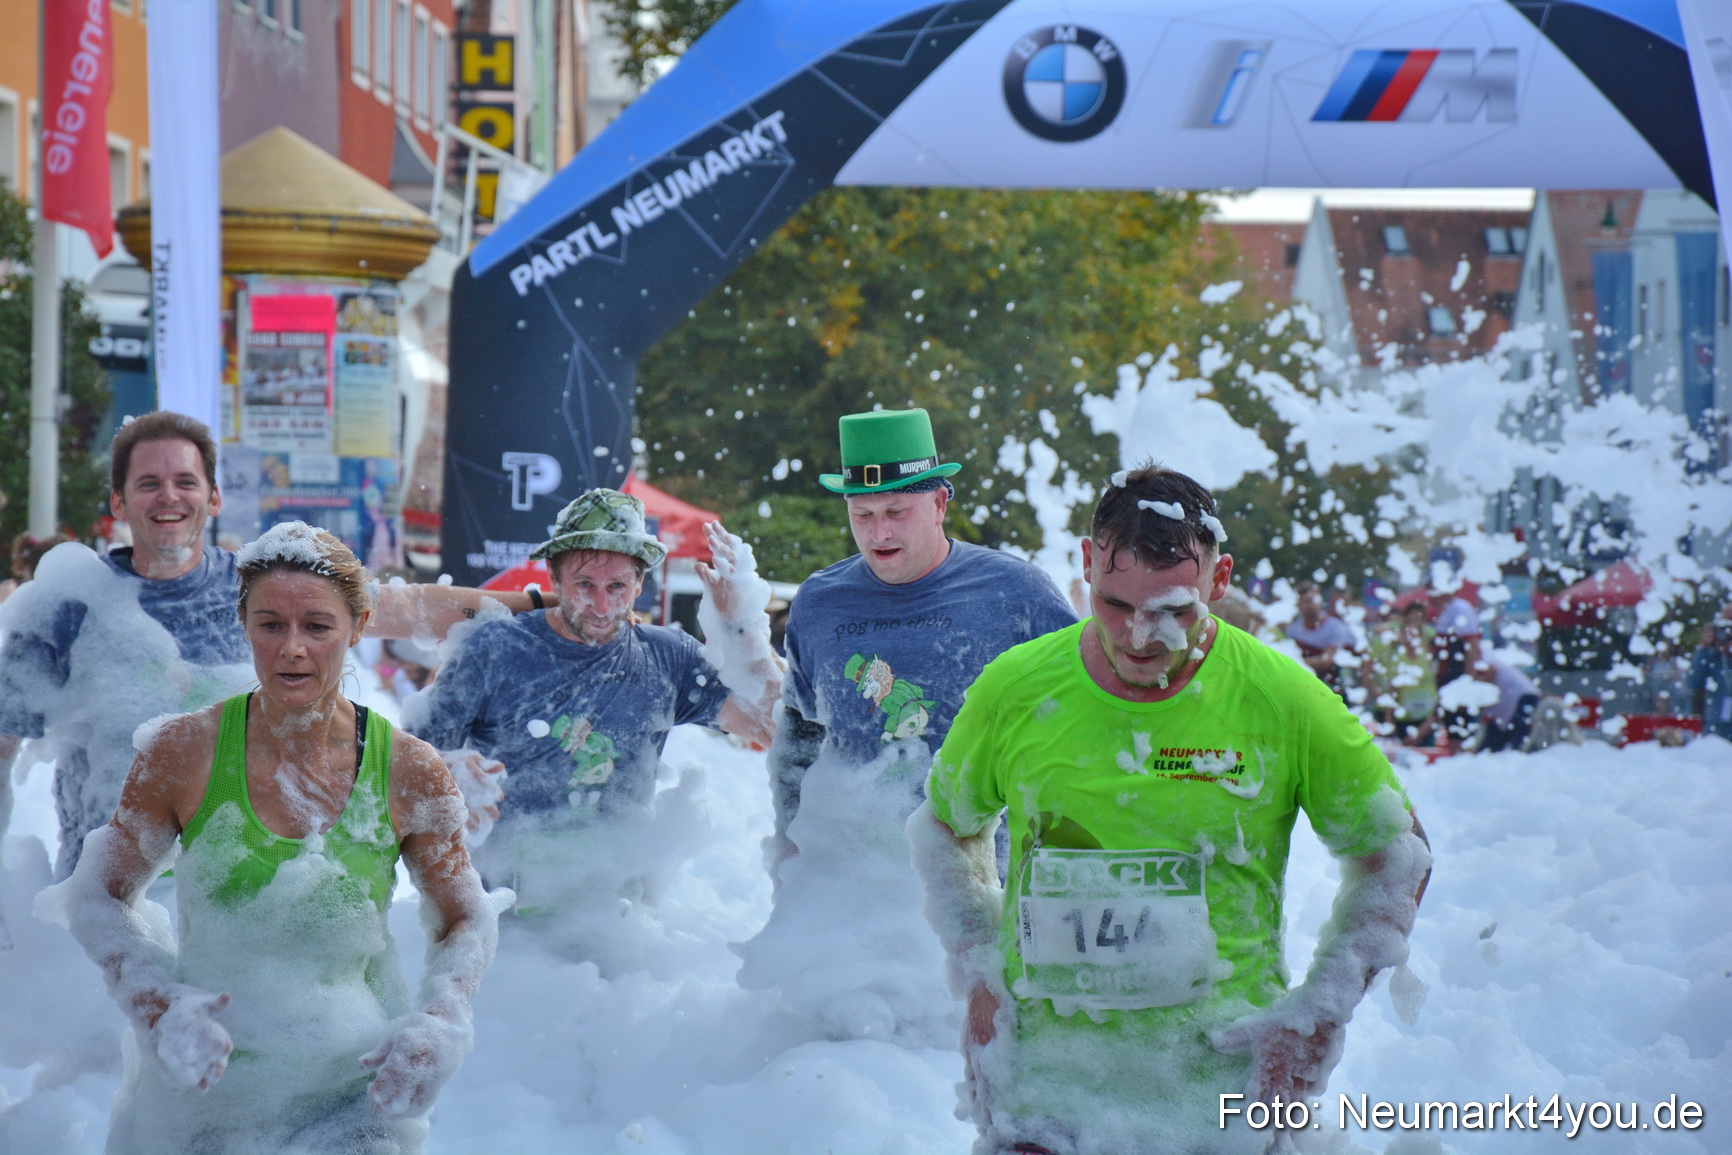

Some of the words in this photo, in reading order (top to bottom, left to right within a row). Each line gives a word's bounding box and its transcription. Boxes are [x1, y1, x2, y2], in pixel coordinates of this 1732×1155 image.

[1013, 24, 1119, 63] BMW
[509, 221, 617, 296] PARTL
[610, 110, 788, 235] NEUMARKT
[1169, 772, 1218, 784] September
